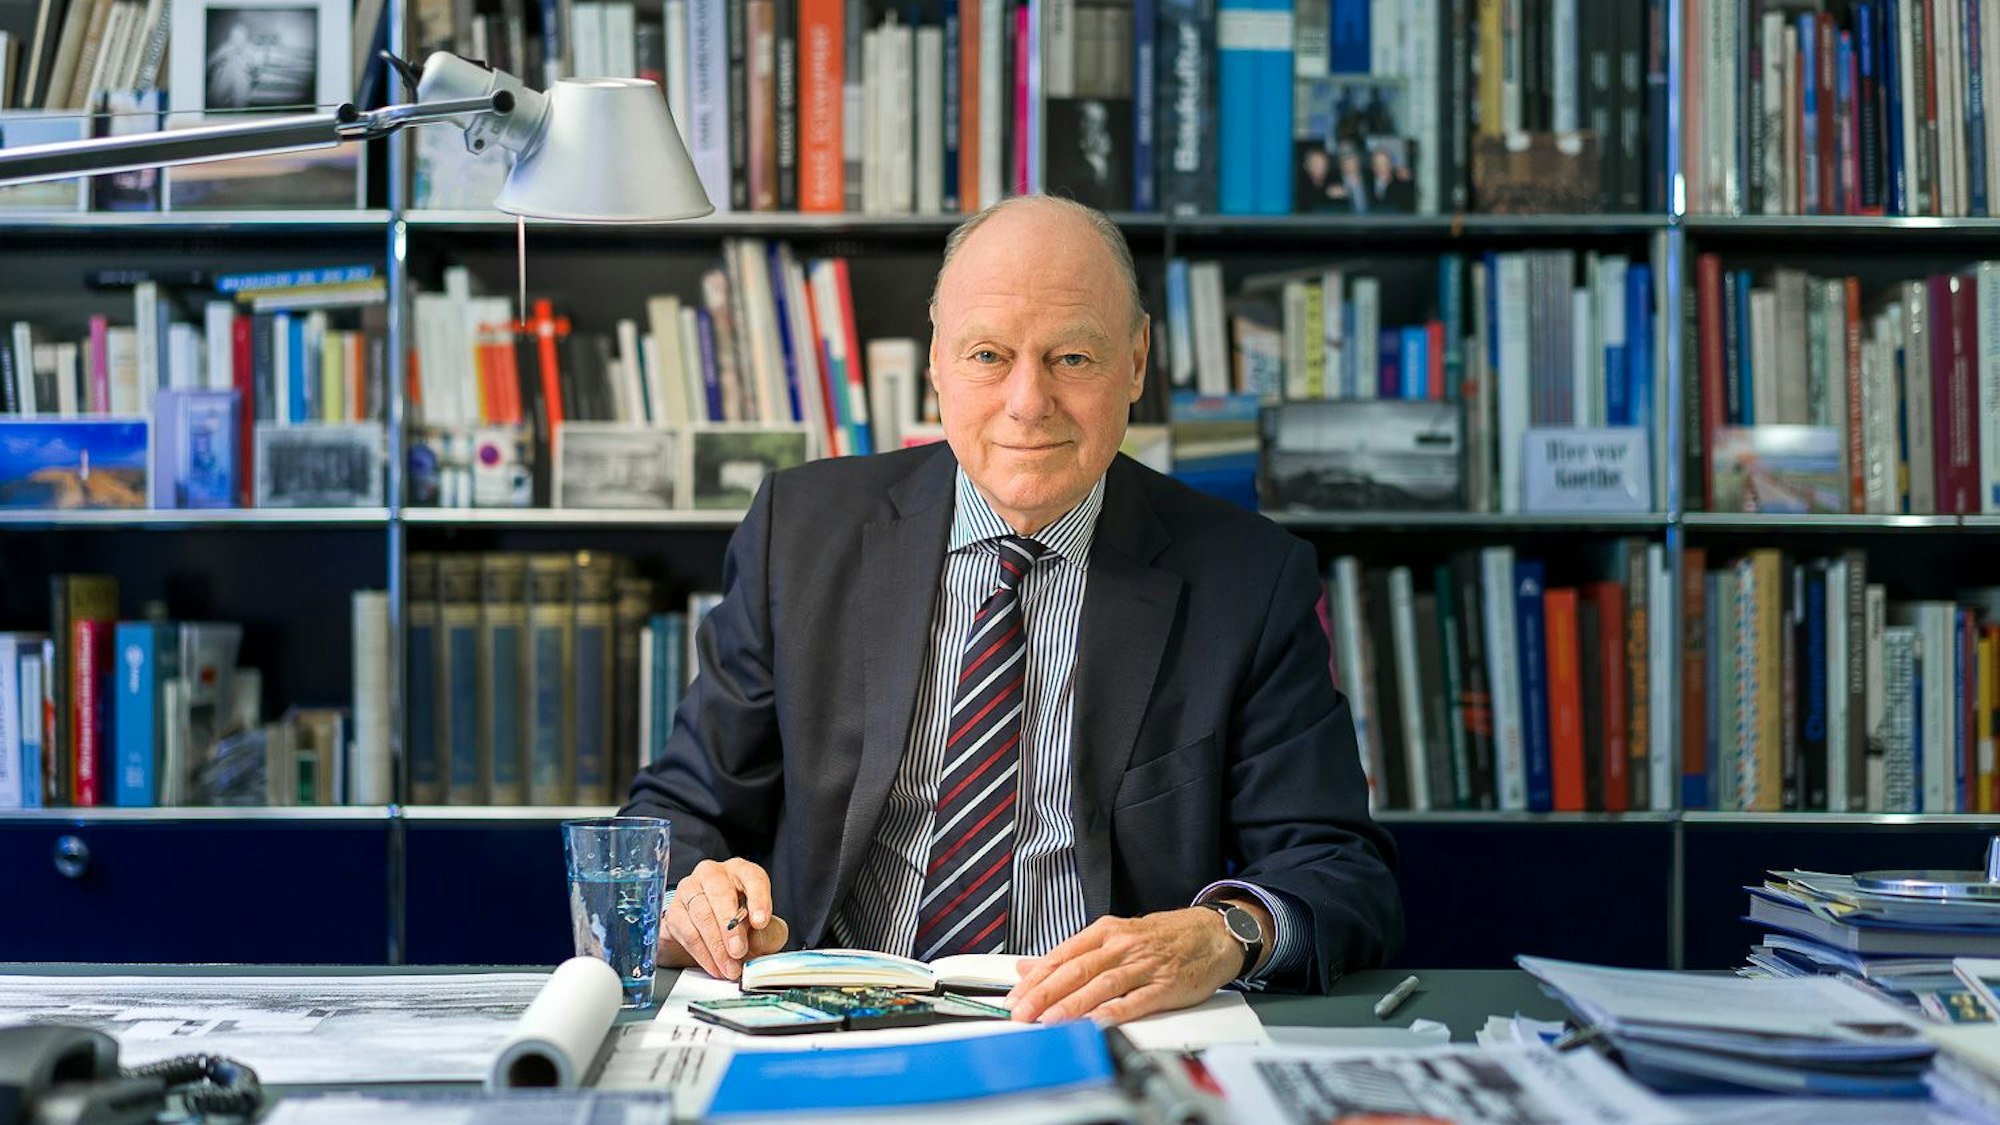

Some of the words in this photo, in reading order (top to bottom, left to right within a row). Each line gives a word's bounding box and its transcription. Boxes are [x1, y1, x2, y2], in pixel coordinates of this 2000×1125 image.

[1174, 23, 1200, 171] Baukultur
[1546, 441, 1588, 462] Hier
[1555, 468, 1622, 490] Goethe
